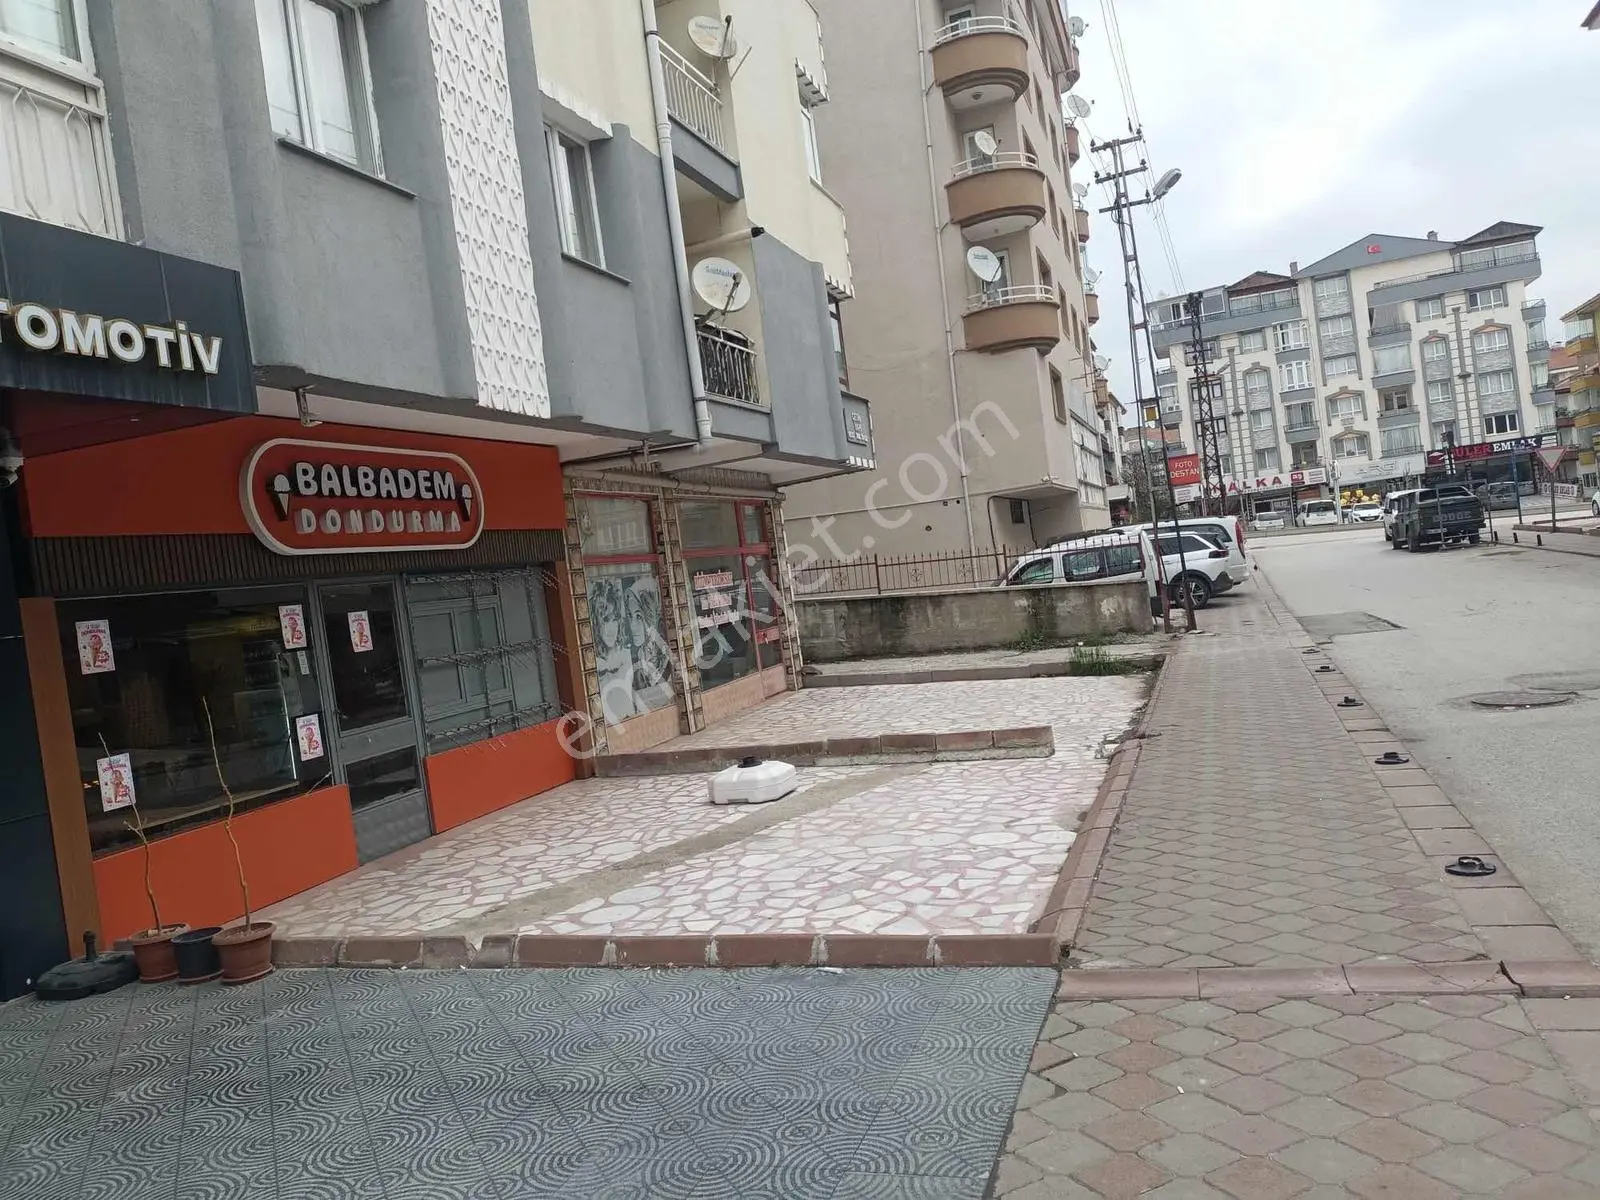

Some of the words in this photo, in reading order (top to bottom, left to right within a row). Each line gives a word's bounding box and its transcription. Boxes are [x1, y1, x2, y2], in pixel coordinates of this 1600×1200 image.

[1174, 460, 1193, 468] FOTO
[295, 462, 457, 500] BALBADEM
[295, 508, 461, 534] DONDURMA
